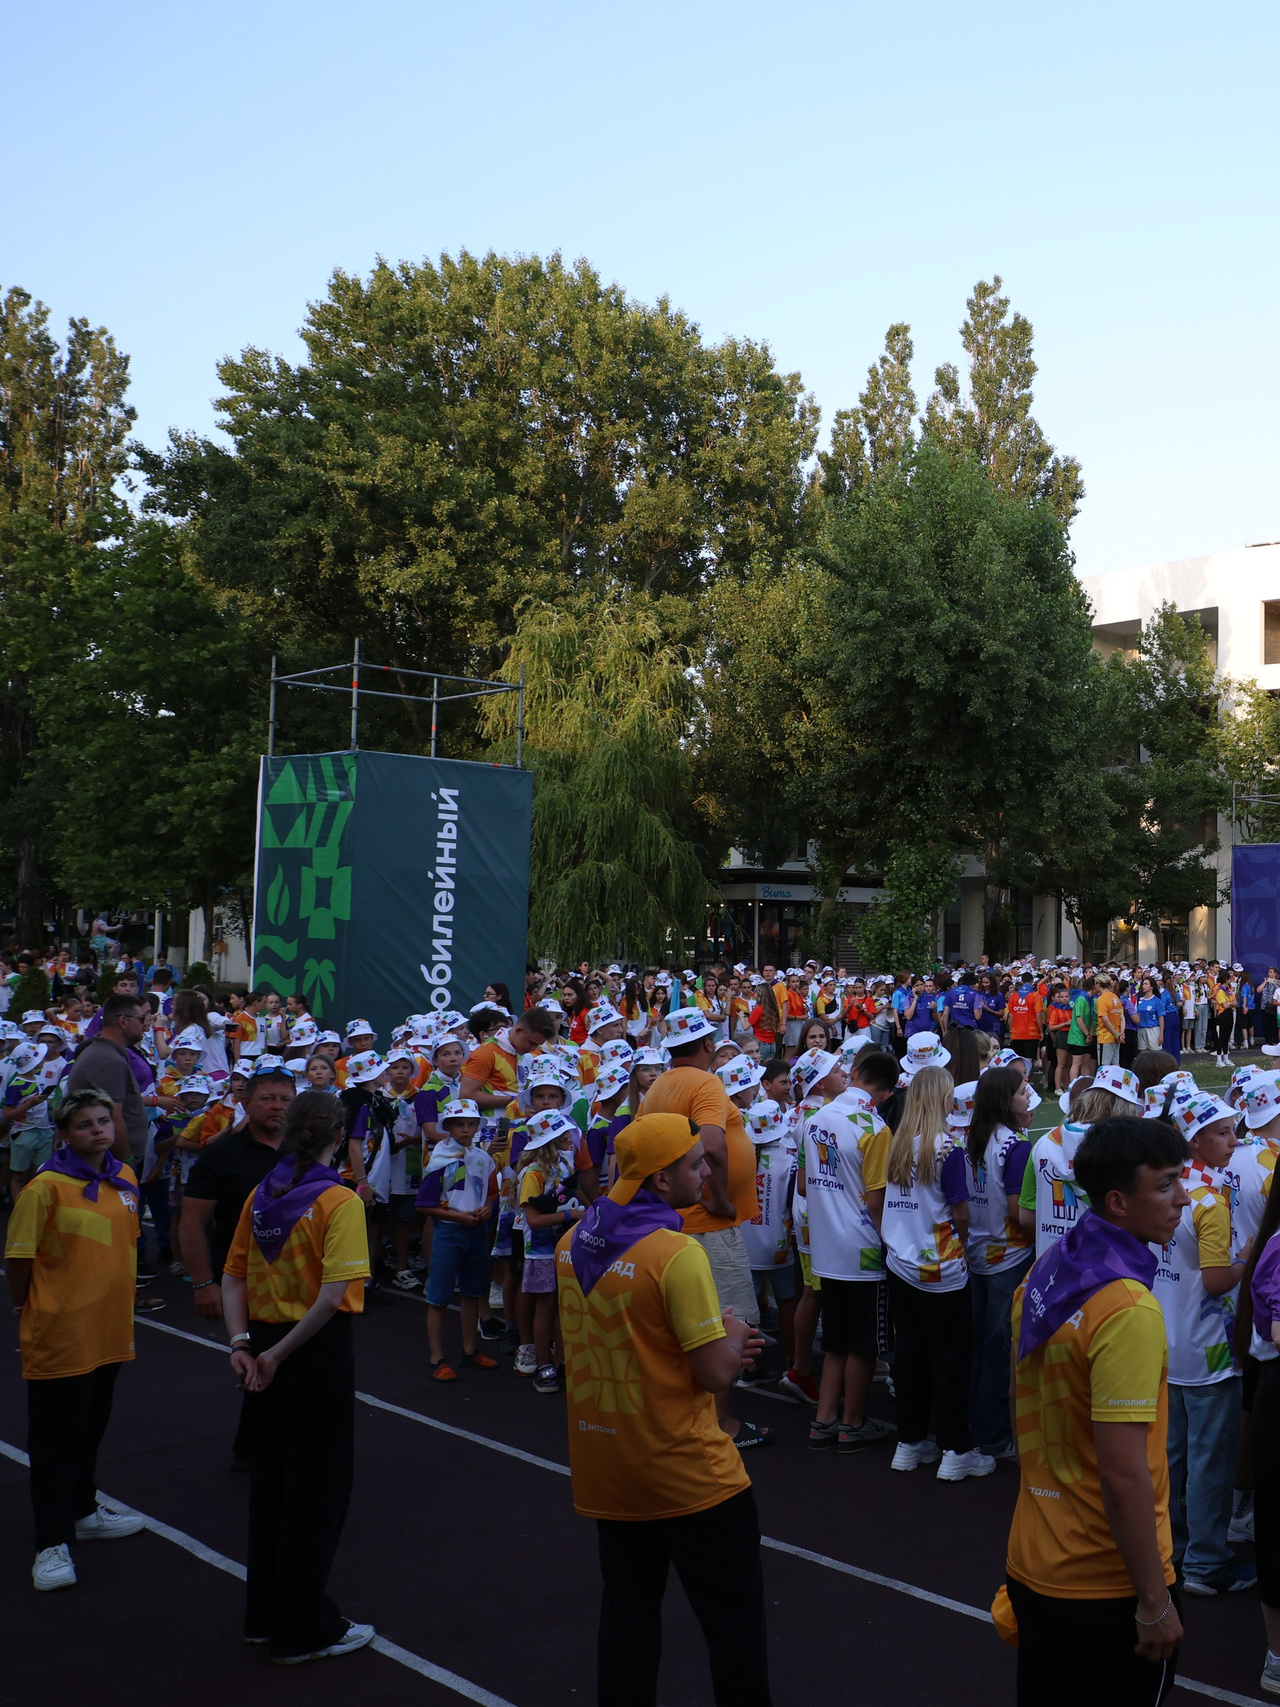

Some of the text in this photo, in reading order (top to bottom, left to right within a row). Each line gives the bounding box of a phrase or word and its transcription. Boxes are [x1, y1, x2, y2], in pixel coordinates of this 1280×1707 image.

[1041, 1223, 1065, 1235] вита
[1108, 1398, 1147, 1406] виталия
[734, 1438, 759, 1448] adidas
[1028, 1486, 1061, 1498] талия
